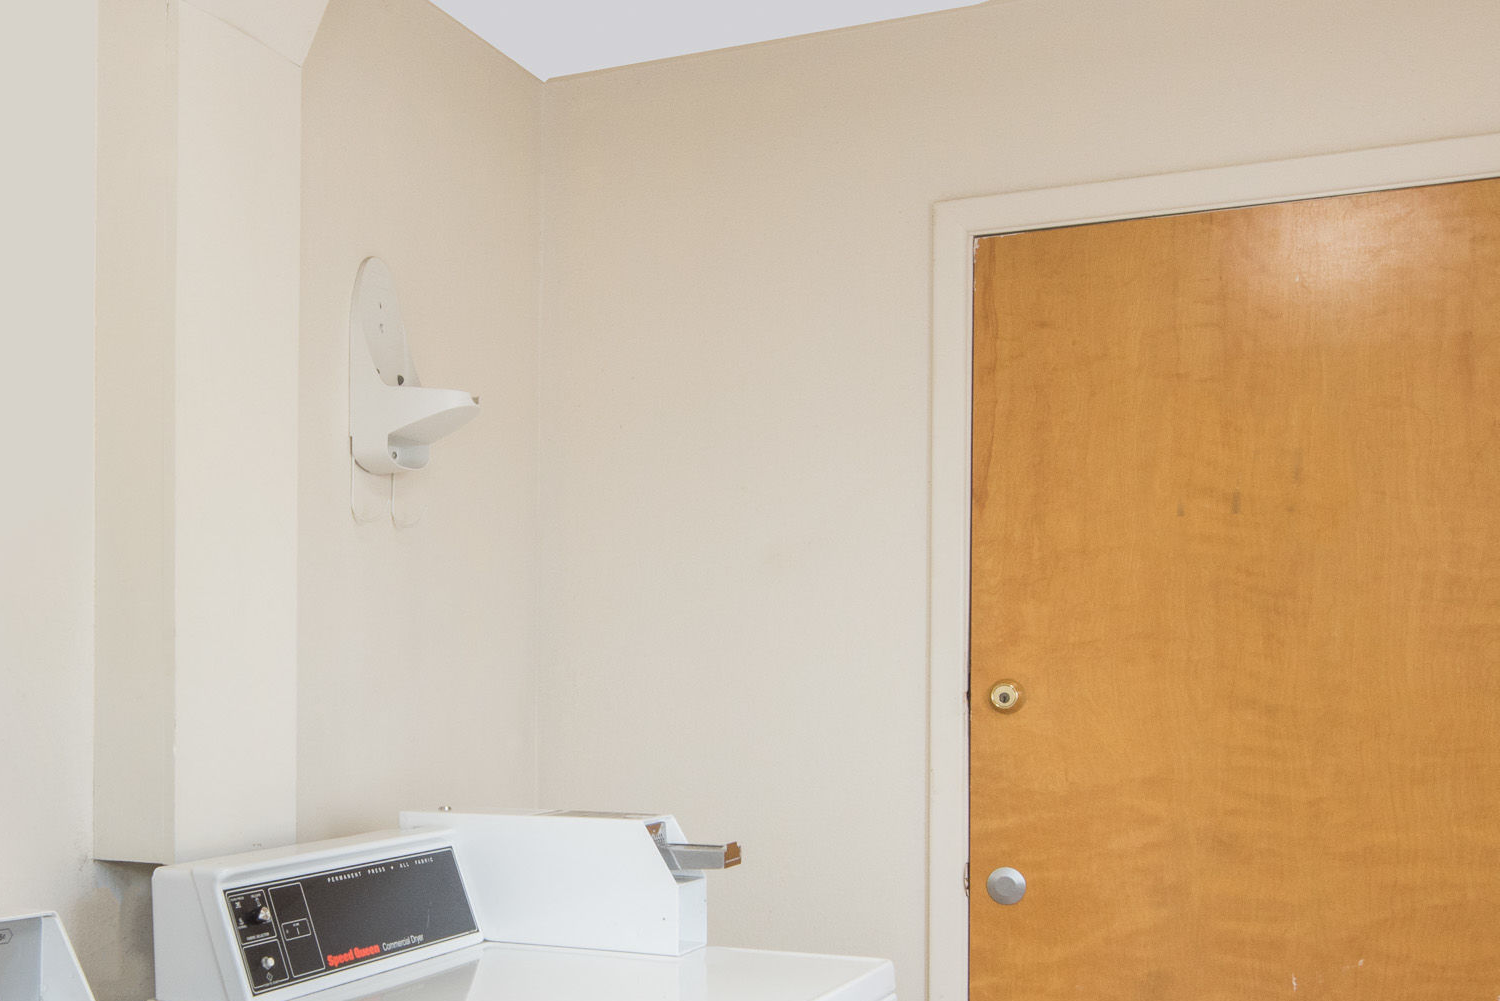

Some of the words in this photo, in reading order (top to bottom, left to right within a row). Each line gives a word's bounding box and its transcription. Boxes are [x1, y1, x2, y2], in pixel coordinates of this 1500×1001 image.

[328, 871, 362, 884] PERMANENT
[367, 866, 386, 875] PRESS
[399, 861, 410, 869] ALL
[414, 856, 434, 866] FABRIC
[326, 949, 353, 968] Speed
[353, 943, 381, 959] Queen
[382, 936, 410, 952] Commercial
[410, 933, 424, 946] Dryer
